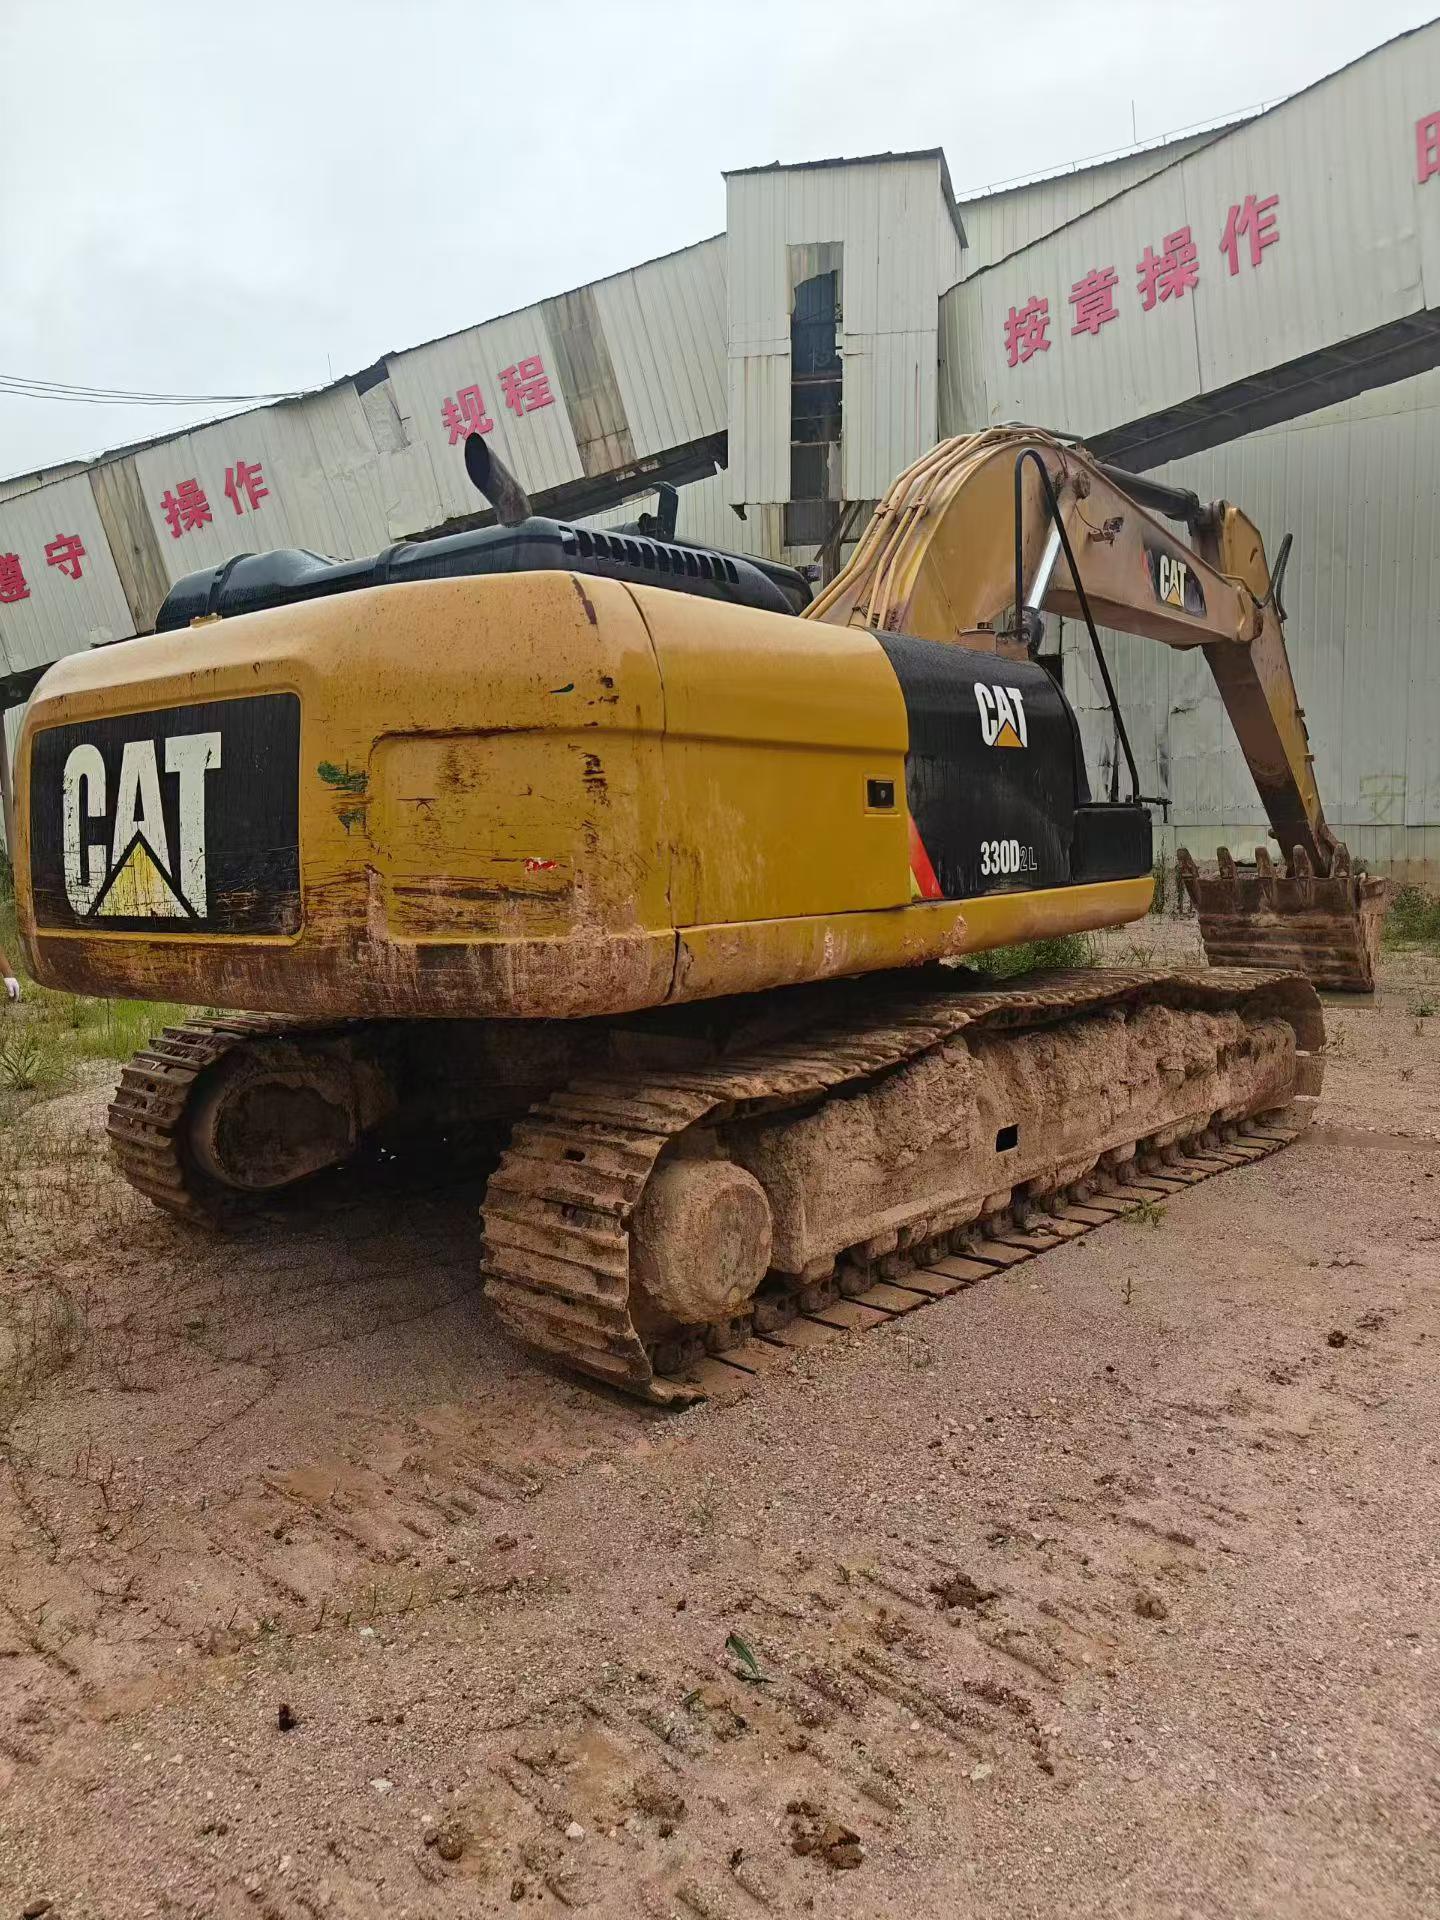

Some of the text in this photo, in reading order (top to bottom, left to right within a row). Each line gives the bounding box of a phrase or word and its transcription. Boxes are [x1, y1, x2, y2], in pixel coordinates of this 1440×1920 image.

[1004, 194, 1280, 368] 按章操作
[160, 460, 271, 539] 操作
[441, 354, 556, 446] 规程
[1160, 554, 1187, 608] CAT
[974, 682, 1028, 748] CAT
[63, 731, 222, 918] CAT
